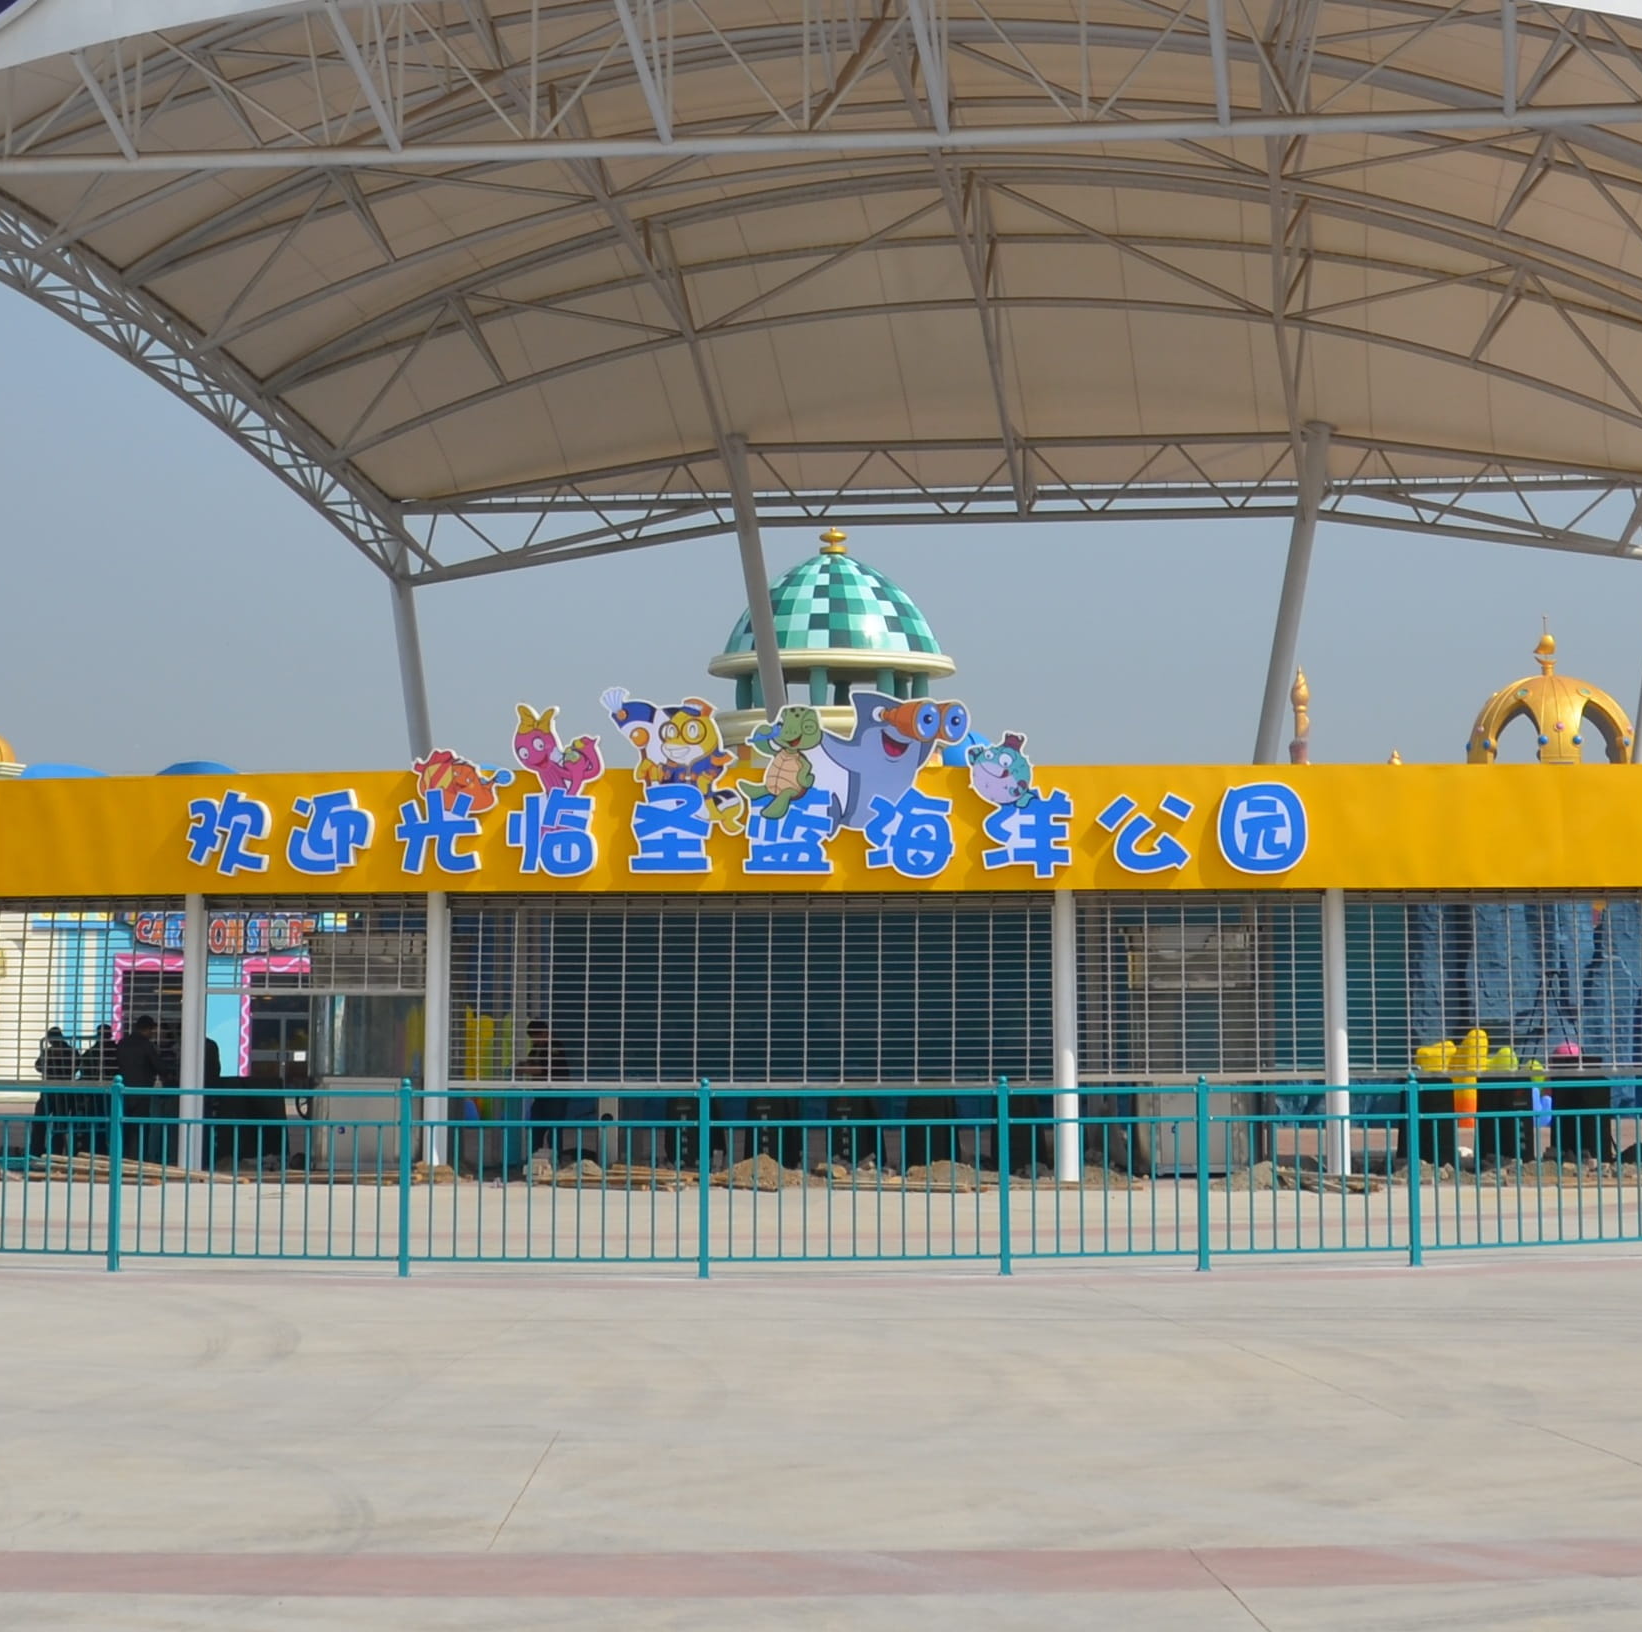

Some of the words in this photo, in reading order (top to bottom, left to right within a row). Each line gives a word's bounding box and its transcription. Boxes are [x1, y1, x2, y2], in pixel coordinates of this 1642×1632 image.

[186, 782, 1308, 878] 欢迎光临圣蓝海洋公园
[136, 918, 244, 954] CARON
